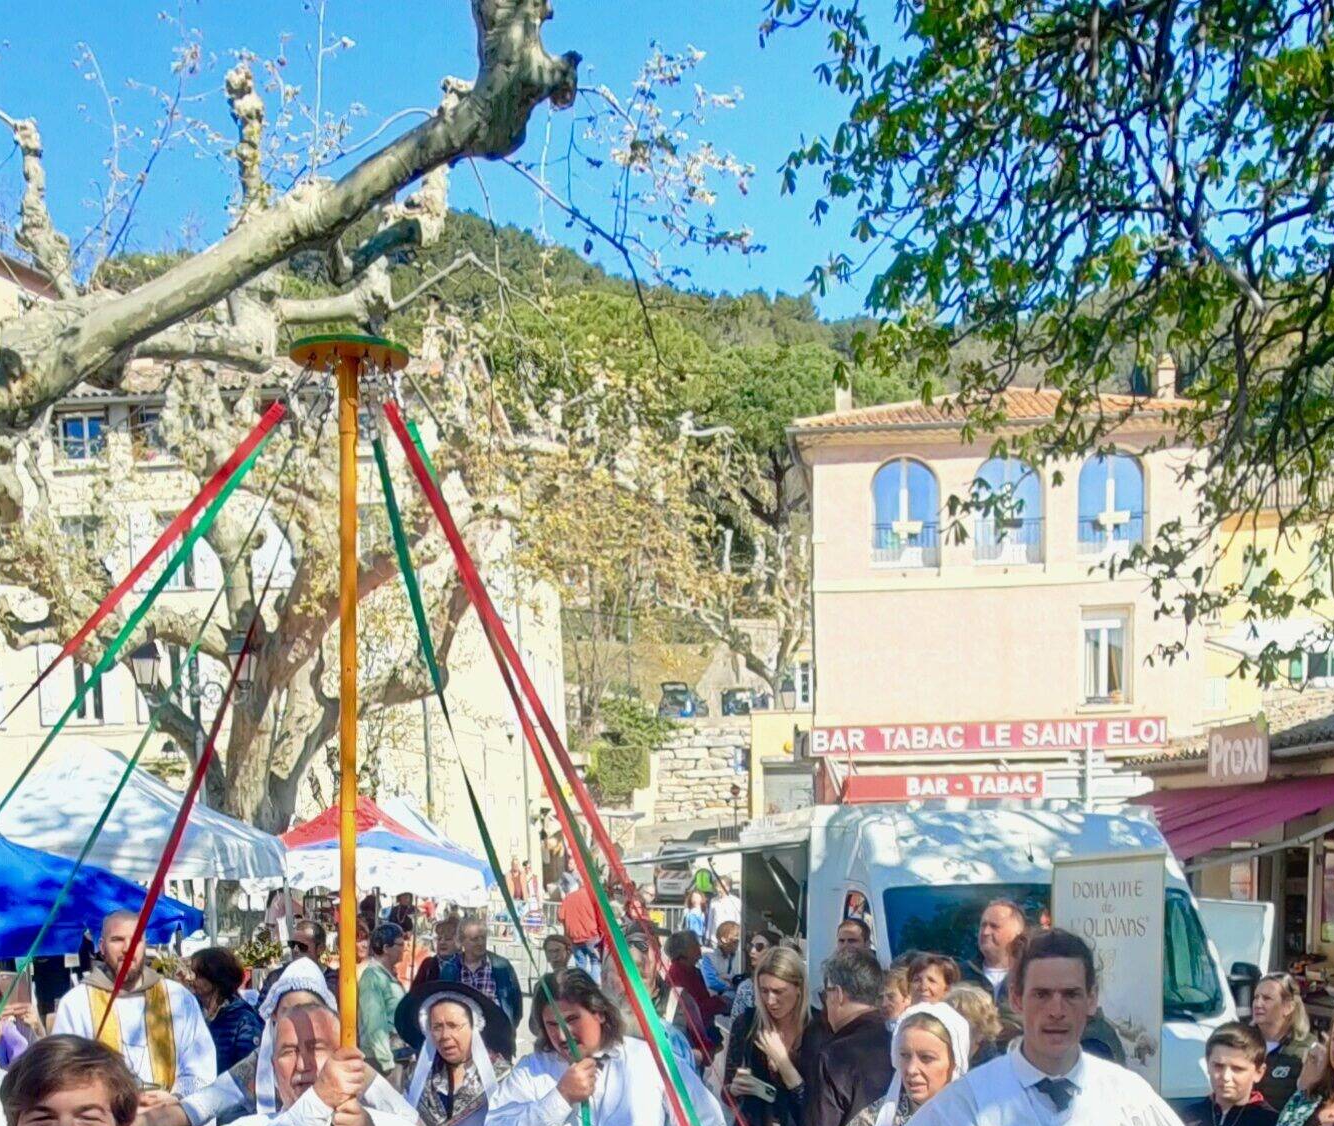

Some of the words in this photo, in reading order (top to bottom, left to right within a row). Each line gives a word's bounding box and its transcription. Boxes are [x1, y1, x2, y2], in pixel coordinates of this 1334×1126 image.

[812, 727, 866, 752] BAR
[878, 725, 965, 750] TABAC
[978, 723, 1012, 747] LE
[1021, 721, 1099, 746] SAINT
[1106, 719, 1166, 744] ELOI
[905, 776, 949, 796] BAR
[969, 774, 1037, 795] TABAC
[1072, 880, 1145, 899] DOMAINE
